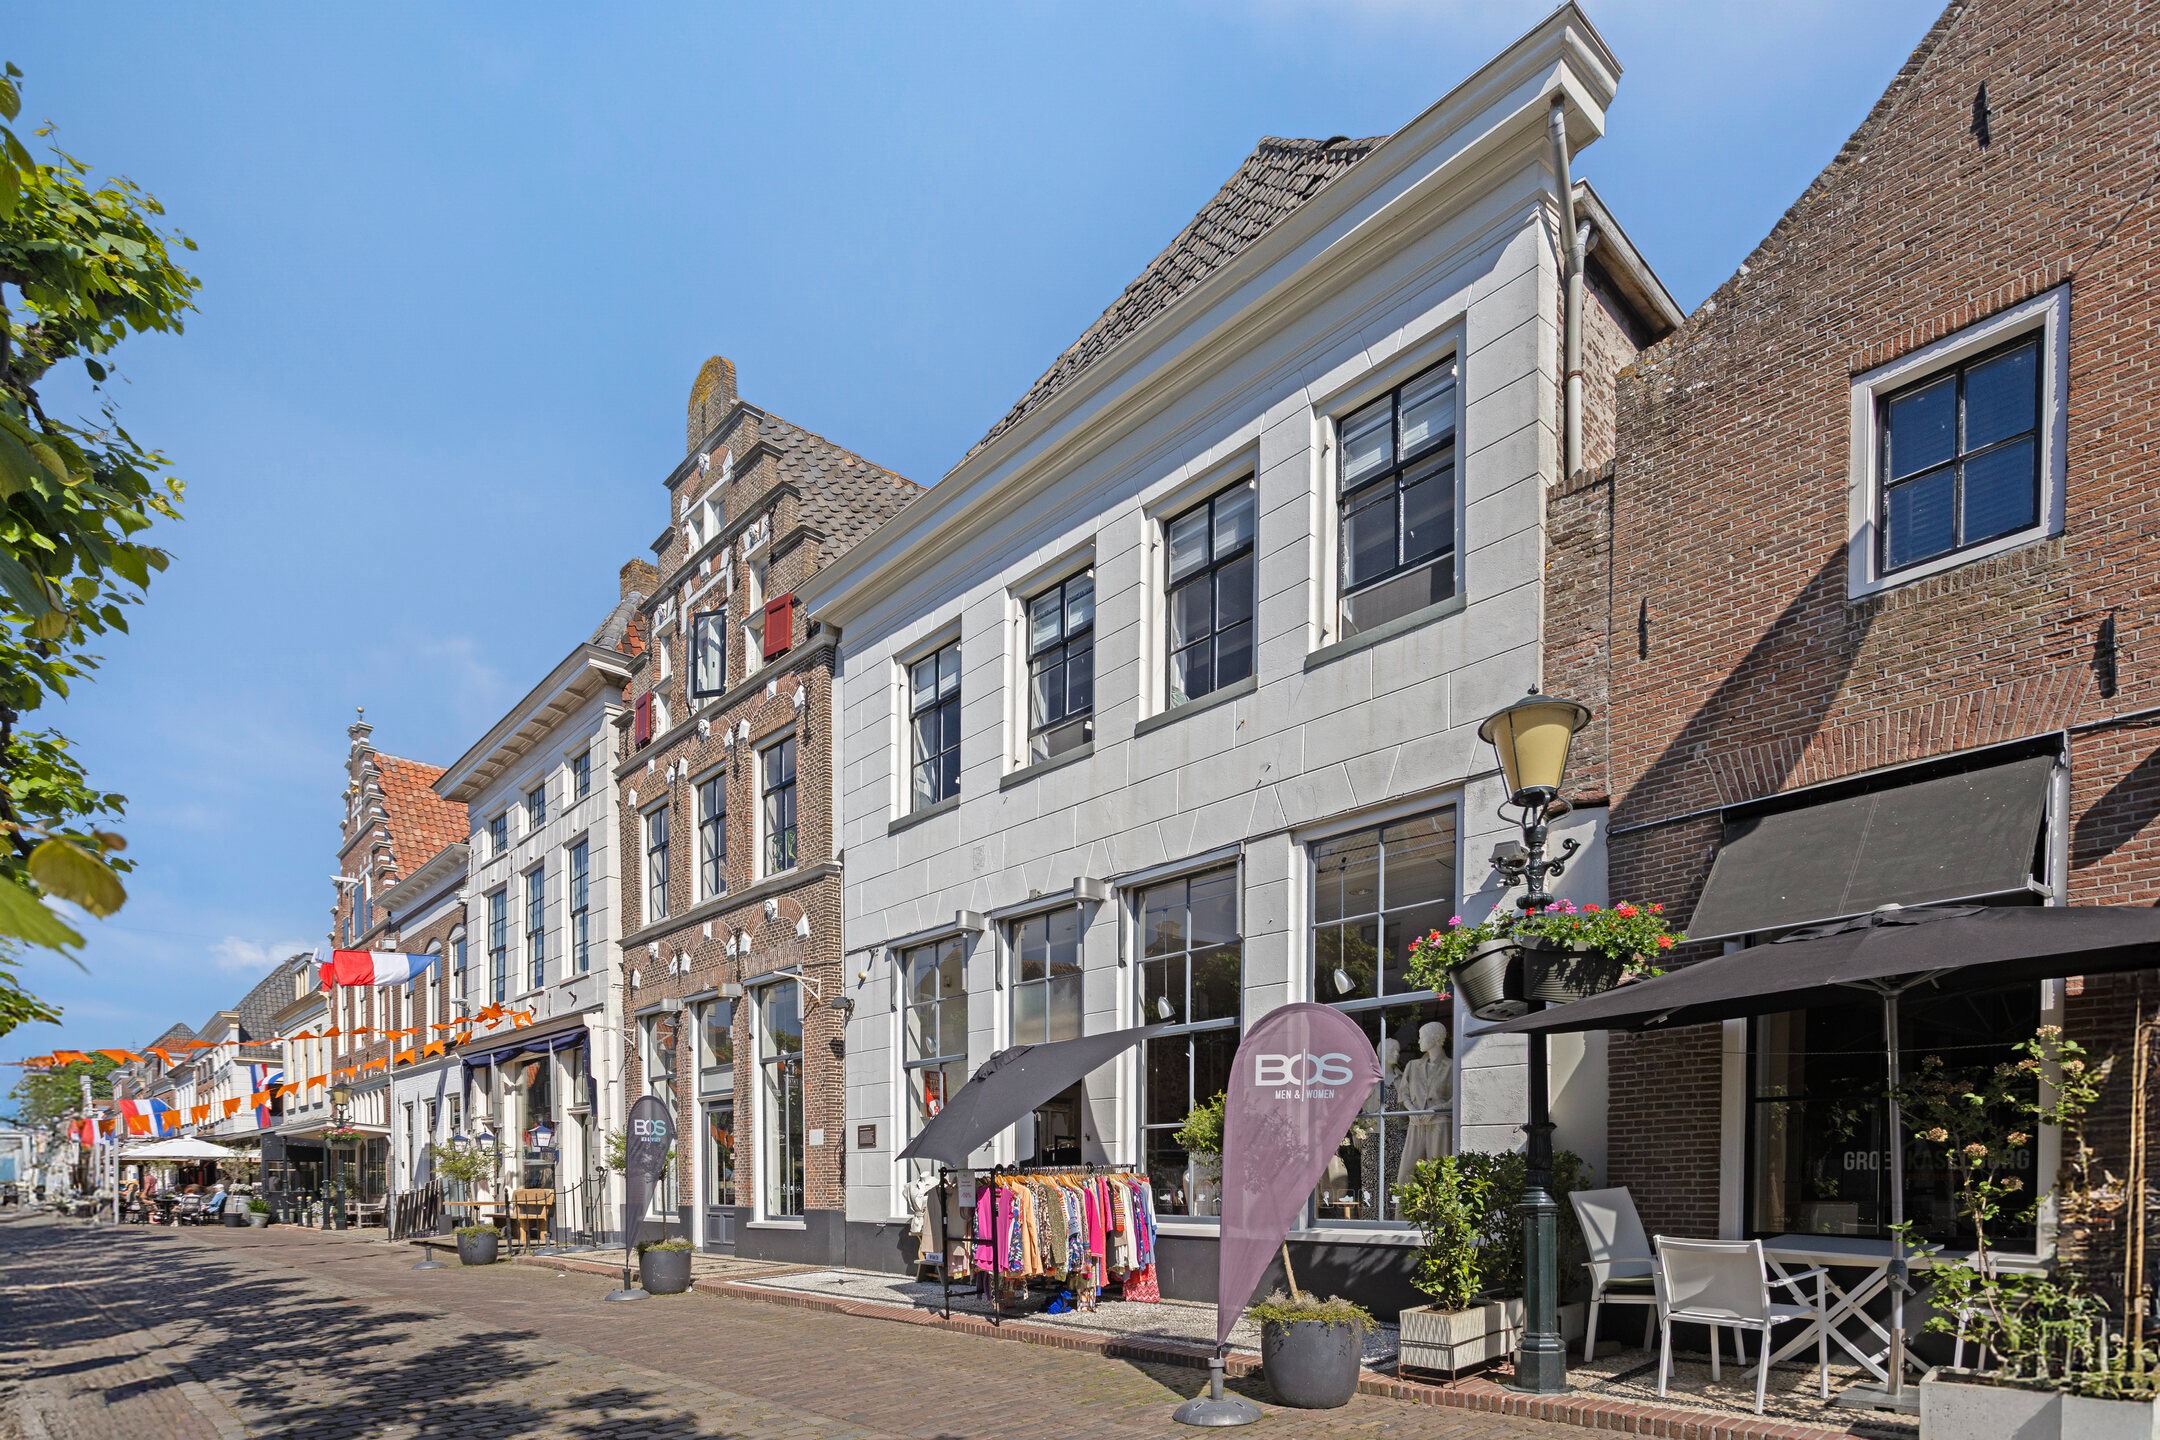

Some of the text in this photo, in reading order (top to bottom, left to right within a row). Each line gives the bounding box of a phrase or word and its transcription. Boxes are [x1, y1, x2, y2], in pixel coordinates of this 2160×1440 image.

[1255, 1053, 1354, 1086] BOS
[1275, 1089, 1335, 1100] MEN & WOMEN
[634, 1119, 667, 1136] BOS
